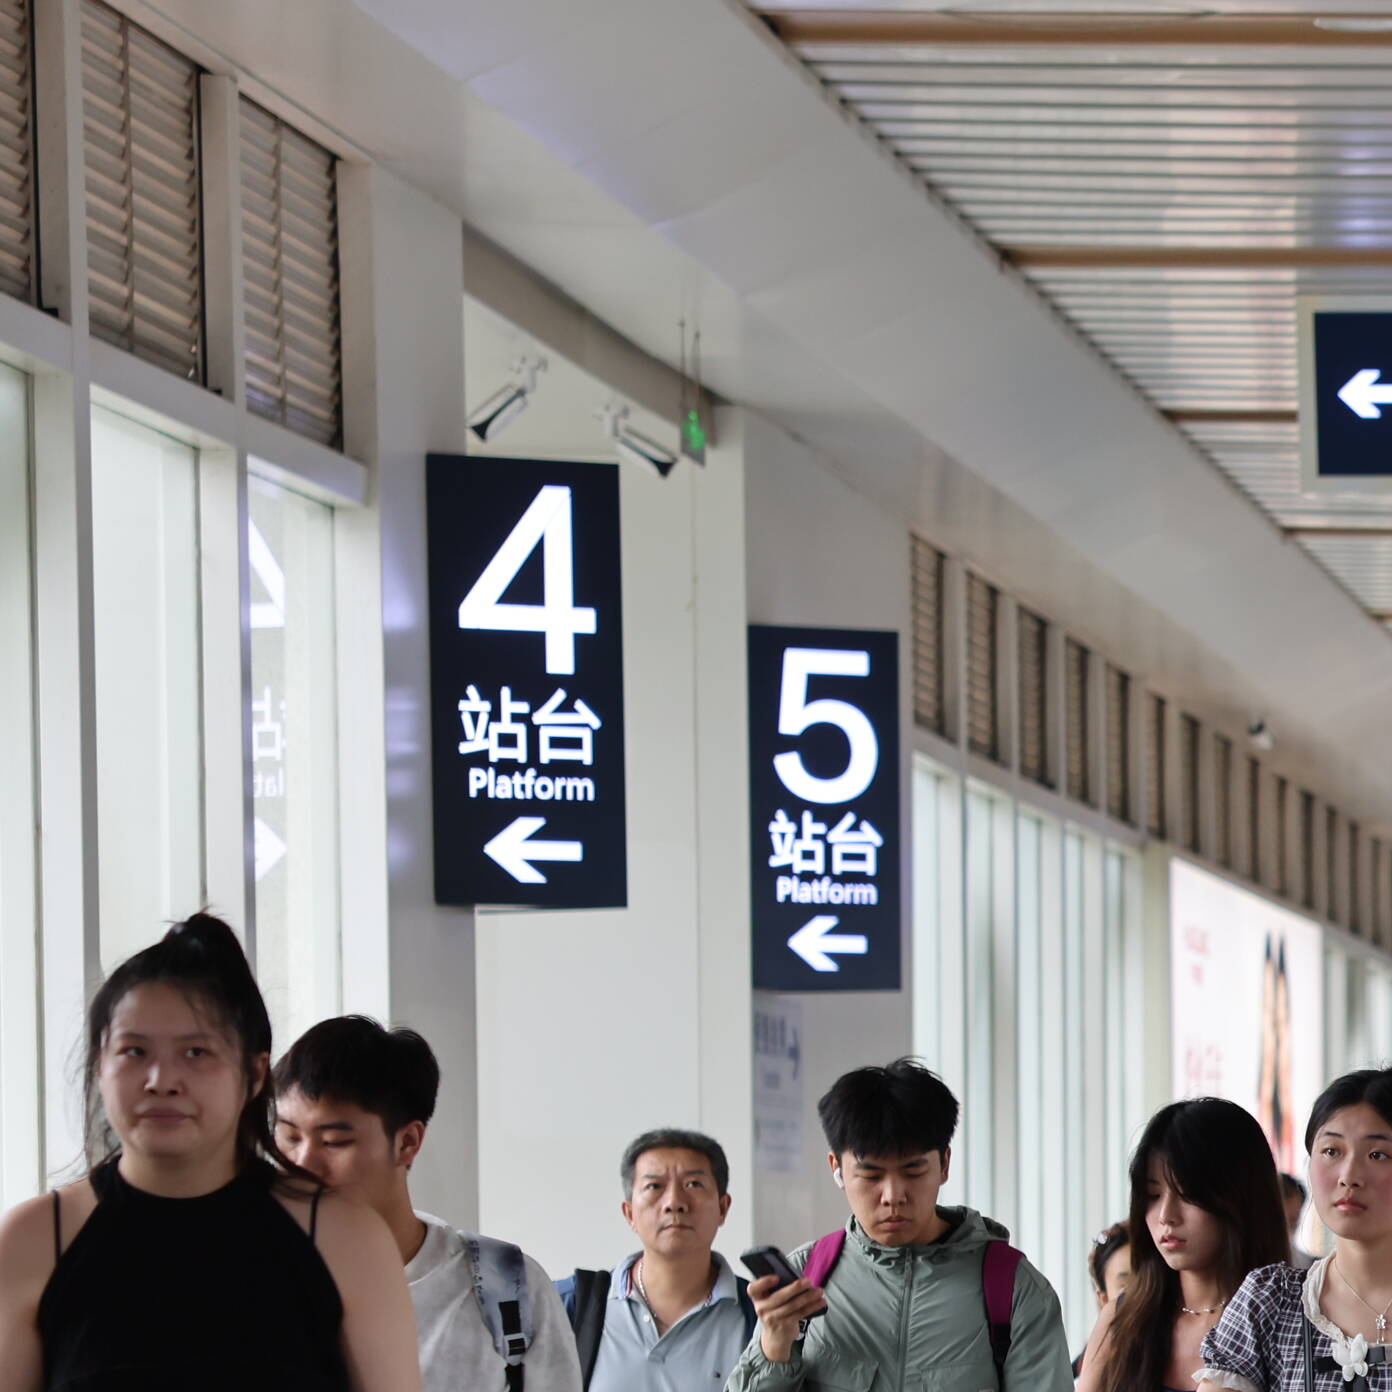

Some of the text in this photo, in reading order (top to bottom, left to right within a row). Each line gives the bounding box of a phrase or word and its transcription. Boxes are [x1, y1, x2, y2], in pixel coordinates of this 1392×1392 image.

[458, 484, 597, 676] 4
[458, 684, 602, 766] 站台
[773, 647, 879, 805] 5
[468, 767, 595, 801] Platform
[768, 808, 883, 876] 站台
[776, 876, 878, 905] Platform
